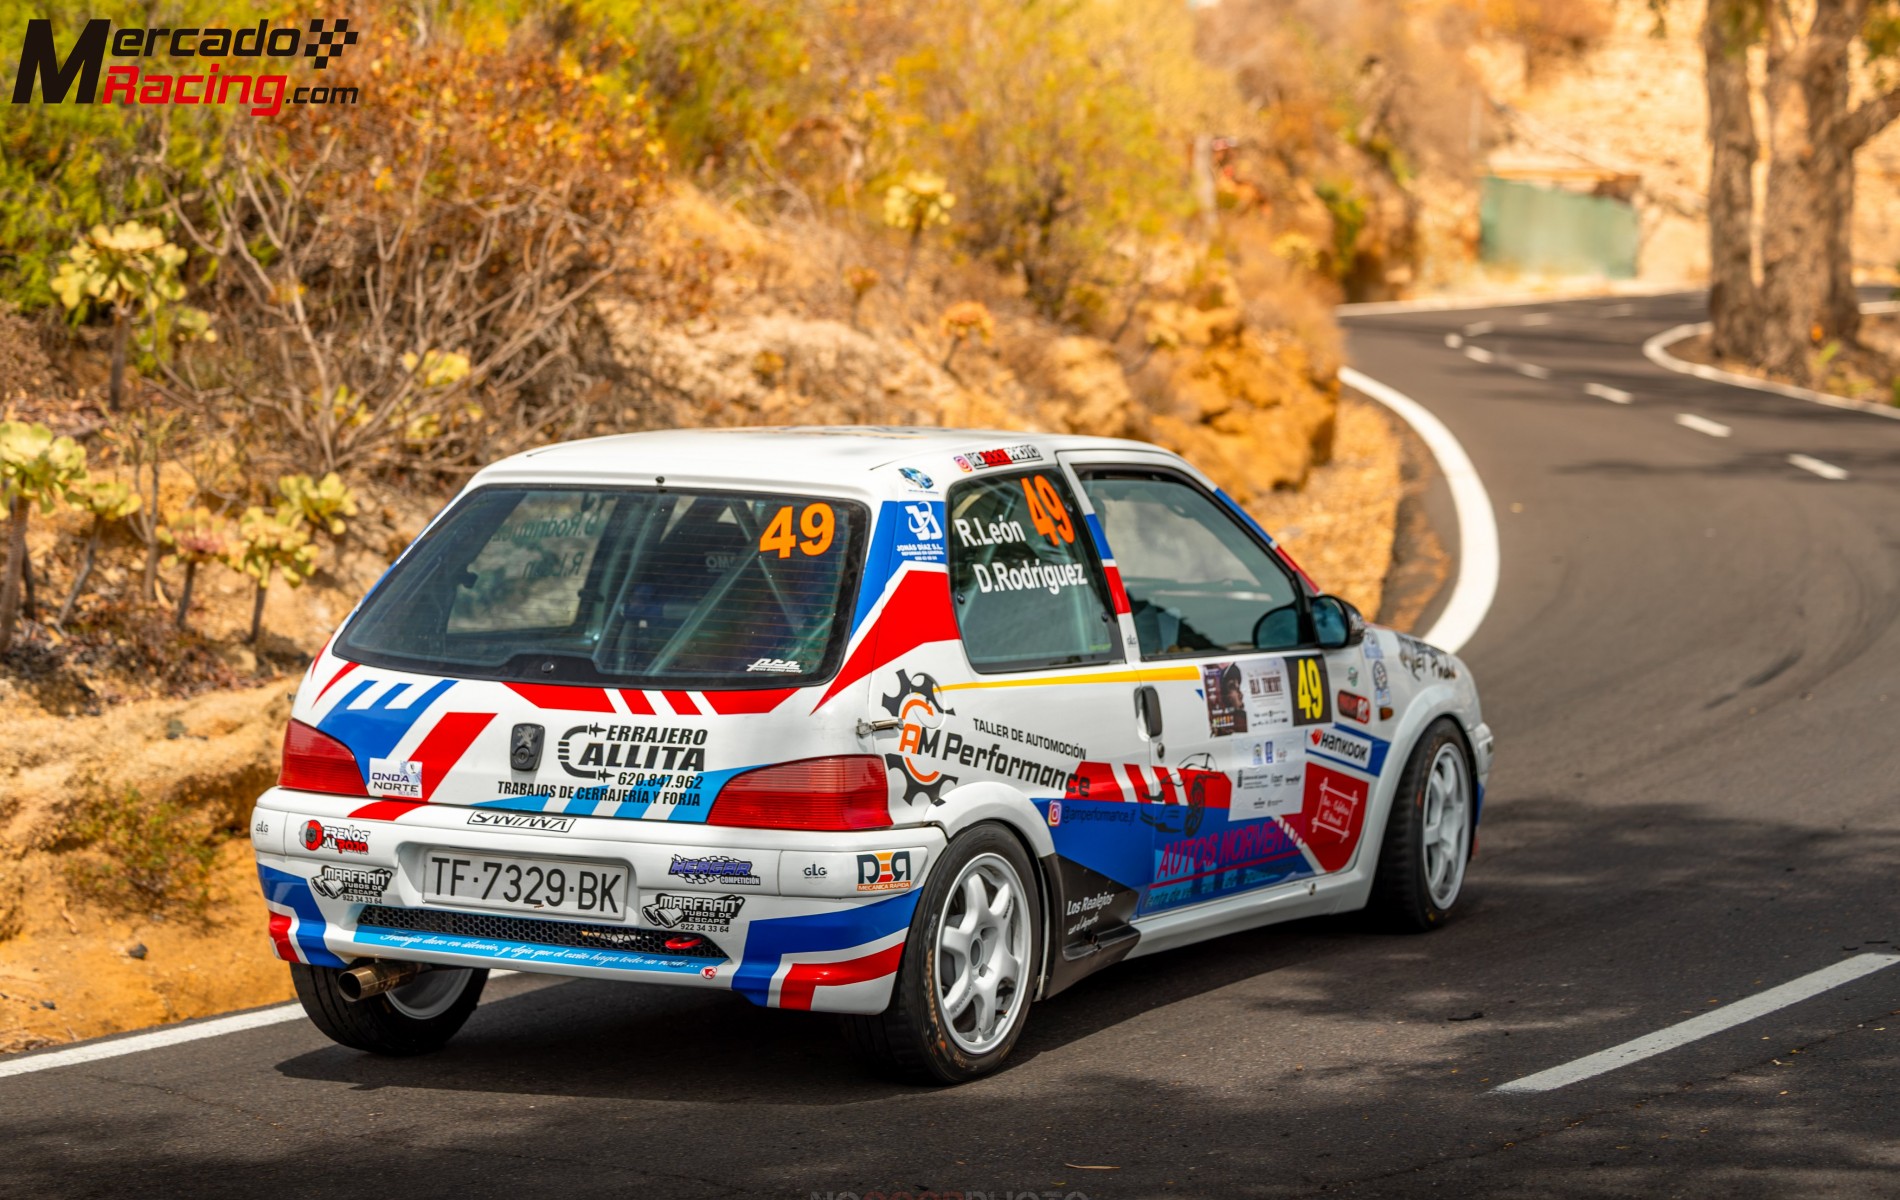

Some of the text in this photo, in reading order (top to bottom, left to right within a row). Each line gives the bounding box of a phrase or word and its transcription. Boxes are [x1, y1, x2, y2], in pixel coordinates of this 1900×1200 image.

[1020, 474, 1075, 546] 49
[759, 502, 835, 559] 49
[954, 515, 1026, 547] R.León
[973, 559, 1088, 595] D.Rodríguez
[1298, 658, 1323, 719] 49
[973, 718, 1087, 760] TALLER DE AUTOMOCIÓN
[899, 723, 1091, 797] AM Performance
[372, 772, 410, 783] ONDA
[618, 772, 704, 790] 620.847.962
[373, 782, 419, 793] NORTE
[498, 781, 700, 807] TRABAJOS DE CERRAJERÍA Y FORJA
[323, 825, 370, 842] FRENOS
[322, 837, 369, 854] AL ROJO
[1157, 833, 1219, 880] AUTOS
[670, 860, 752, 875] HERGAR
[804, 863, 827, 876] GLG
[324, 868, 385, 886] MARFRAN
[720, 875, 760, 885] COMPETICIÓN
[344, 882, 369, 890] TUBOS
[348, 889, 379, 897] ESCAPE
[660, 896, 736, 912] MARFRAN
[1066, 891, 1115, 916] Los Realejos
[680, 923, 695, 931] 922
[719, 925, 729, 933] 64
[689, 917, 726, 925] ESCAPE
